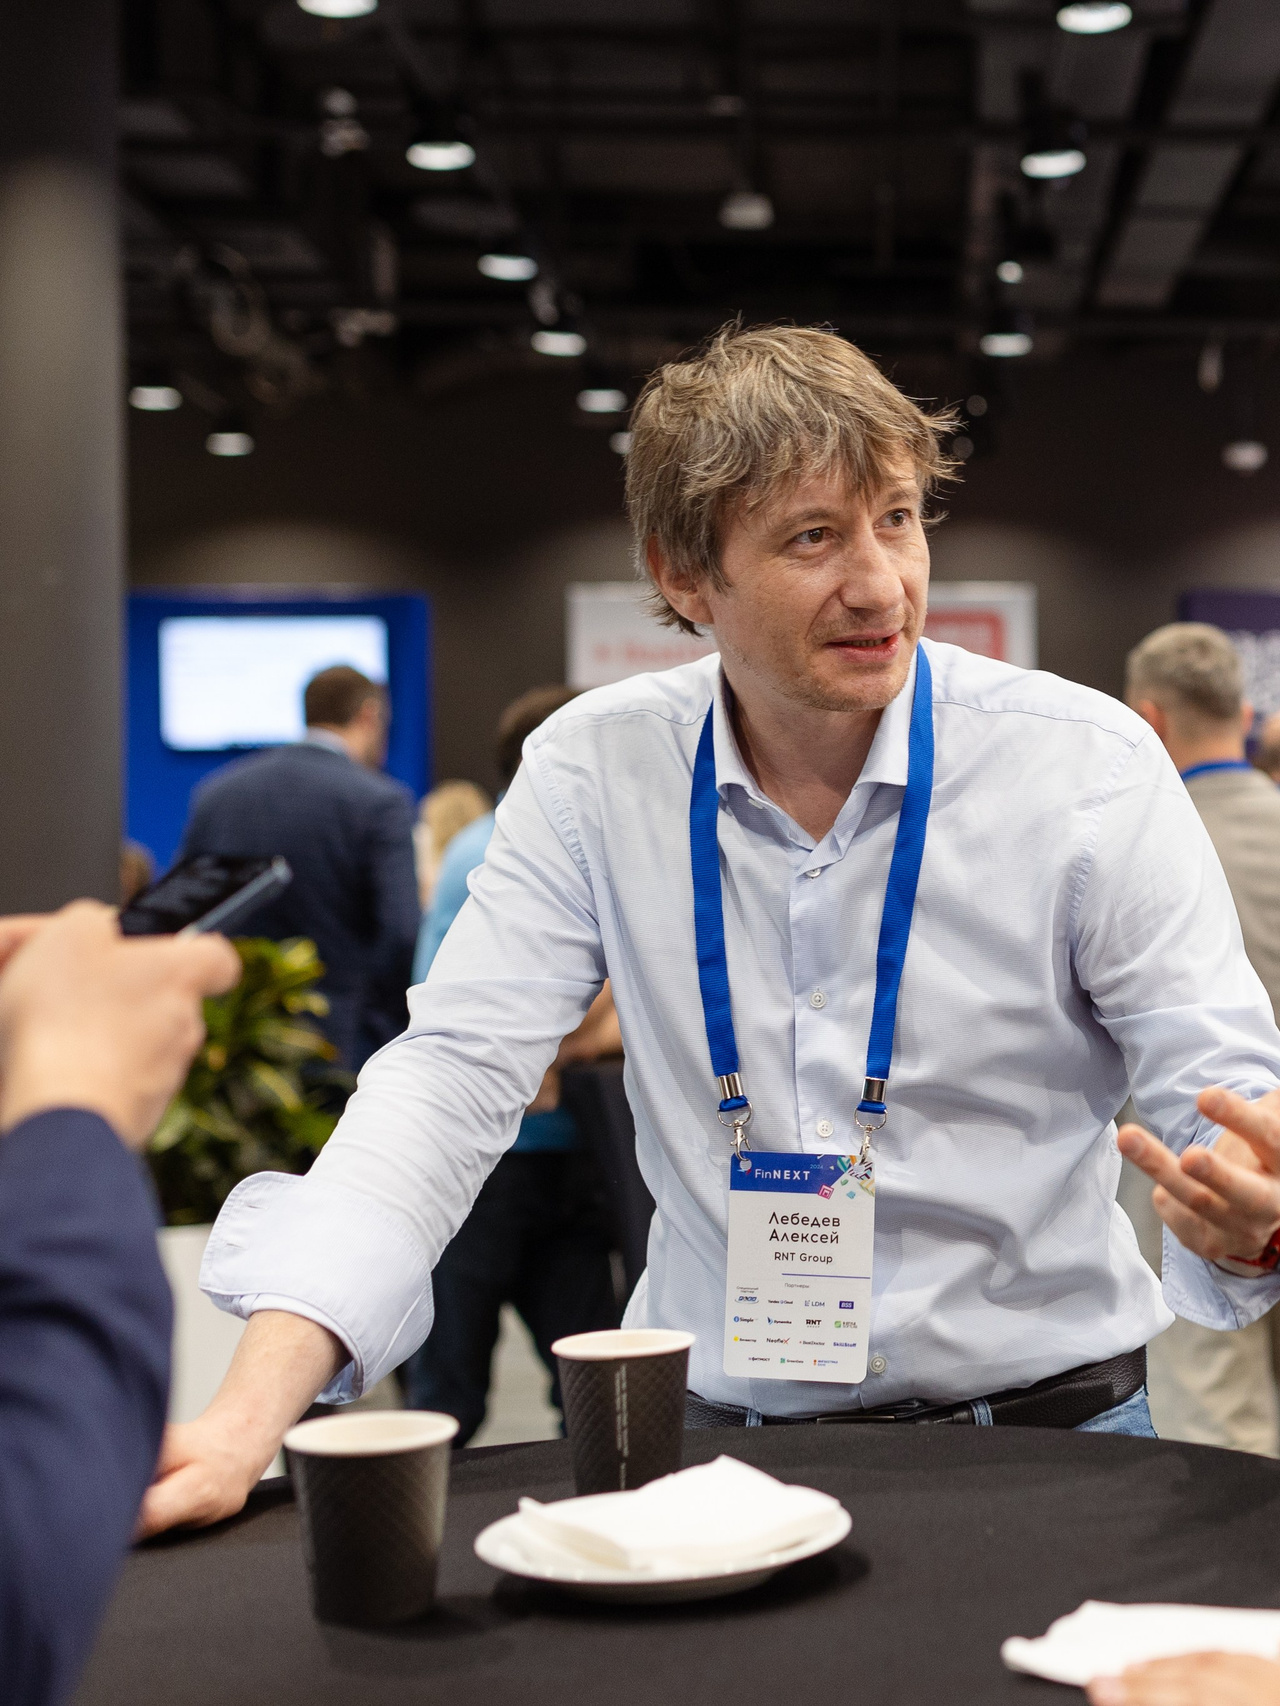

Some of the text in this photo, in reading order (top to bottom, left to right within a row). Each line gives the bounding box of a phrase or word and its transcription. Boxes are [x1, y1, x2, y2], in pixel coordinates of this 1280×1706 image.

[755, 1168, 810, 1180] FinNEXT
[769, 1212, 840, 1228] Лебедев
[769, 1229, 839, 1244] Алексей
[774, 1251, 833, 1265] RNT Group
